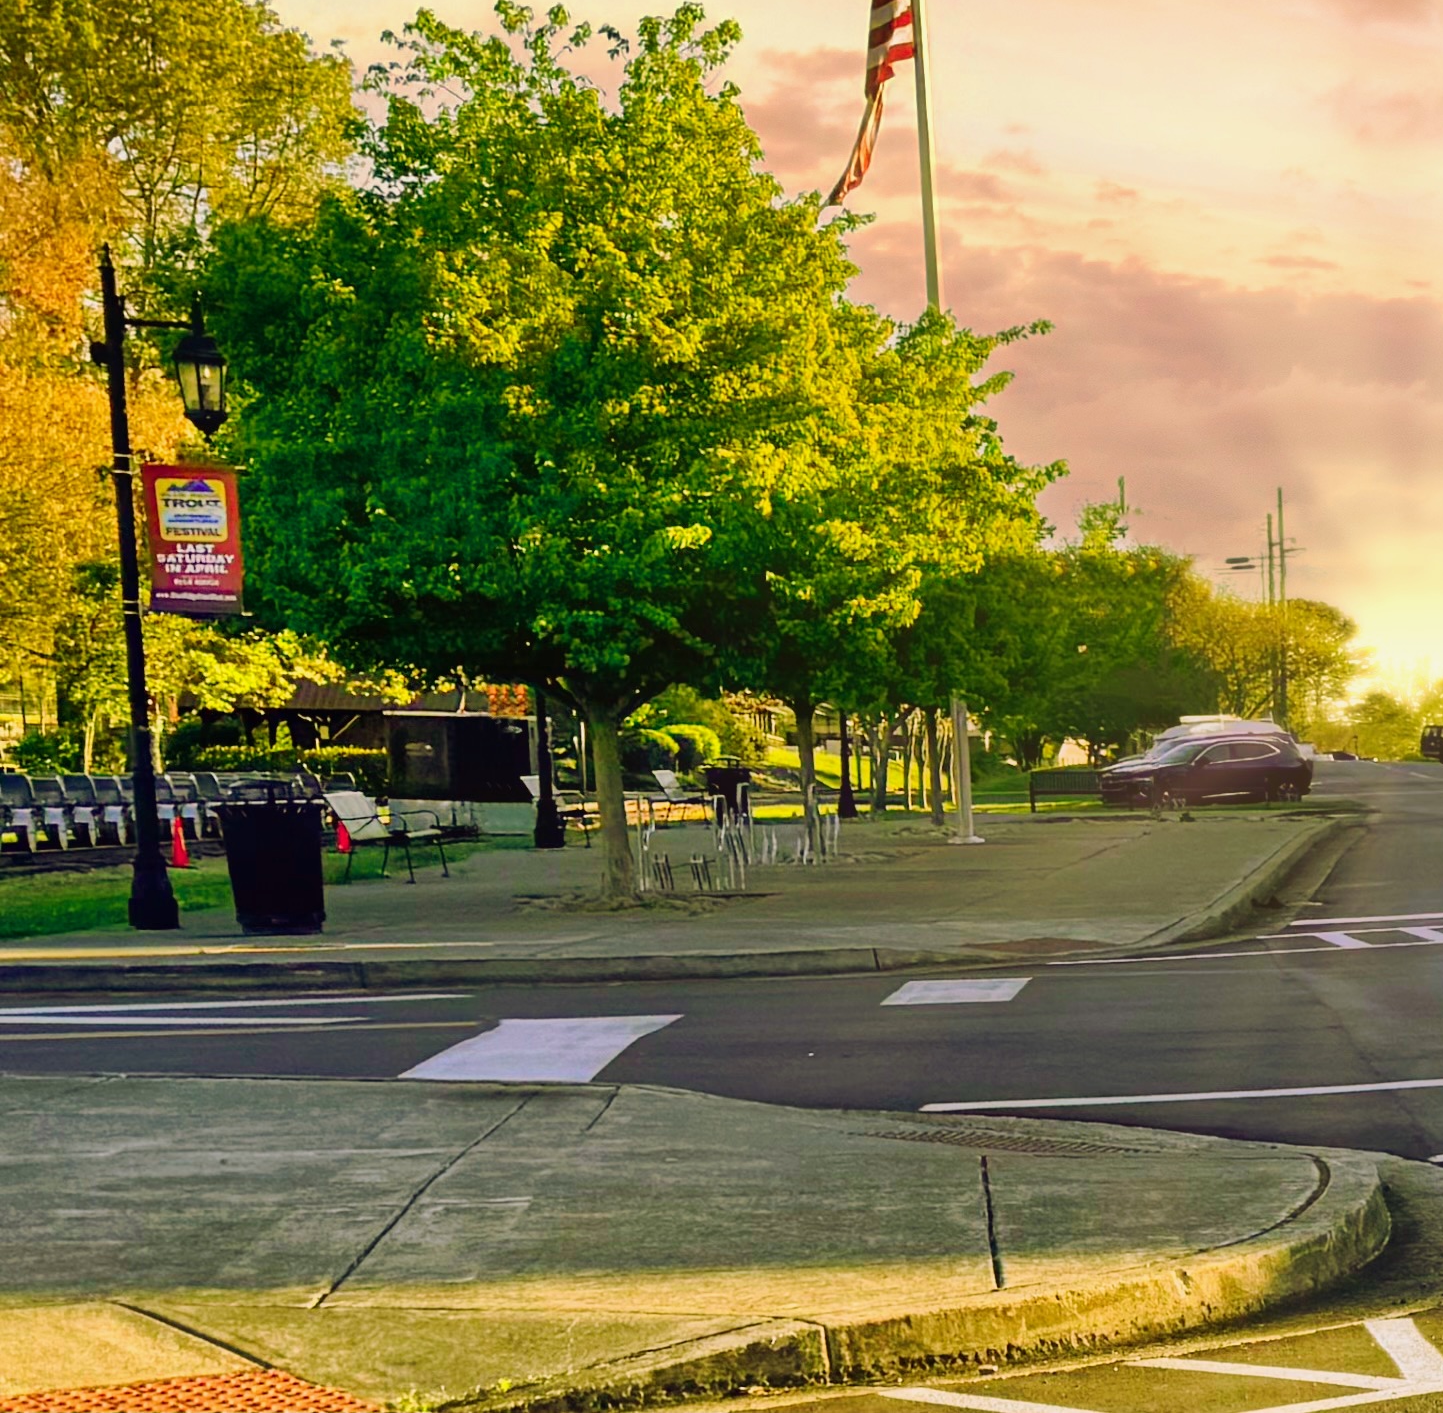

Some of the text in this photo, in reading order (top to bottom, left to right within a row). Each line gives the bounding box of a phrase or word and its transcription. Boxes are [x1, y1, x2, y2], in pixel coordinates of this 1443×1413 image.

[166, 527, 222, 537] FESTIVAL
[176, 542, 215, 553] LAST
[156, 553, 235, 564] SATURDAY
[165, 563, 229, 574] IN APRIL
